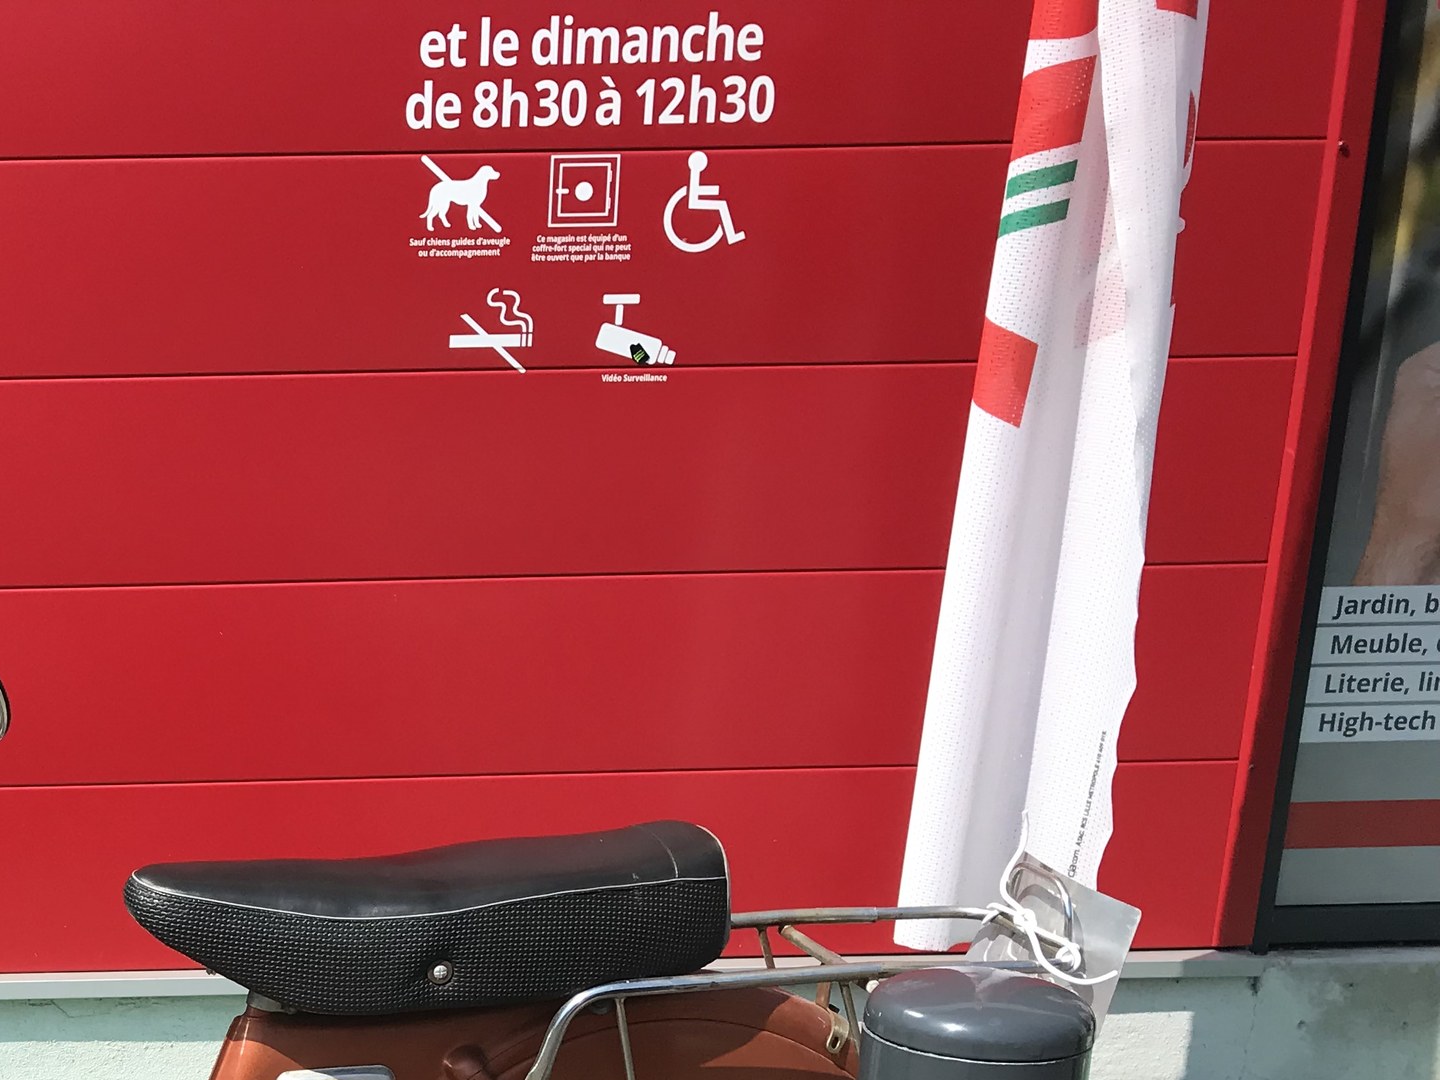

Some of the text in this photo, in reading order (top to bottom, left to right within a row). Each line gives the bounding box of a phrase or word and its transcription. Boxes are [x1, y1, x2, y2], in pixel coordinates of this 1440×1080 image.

[419, 11, 764, 68] et le dimanche
[405, 74, 775, 130] de 8h30 à 12h30
[409, 236, 511, 248] Sauf chiens guides d'aveugle
[536, 234, 546, 243] Ce
[546, 234, 575, 244] magasin
[576, 235, 587, 243] est
[612, 234, 628, 242] d'un
[418, 248, 501, 258] ou d'accompagnement
[532, 244, 567, 252] coffre-fort
[592, 244, 604, 253] qui
[615, 243, 632, 253] peut
[546, 253, 570, 262] ouvert
[570, 254, 584, 263] que
[584, 254, 596, 263] par
[597, 253, 604, 261] la
[604, 252, 631, 262] banque
[601, 373, 668, 382] Vidéo Surveillance
[1331, 593, 1416, 620] Jardin,
[1330, 632, 1428, 655] Meuble,
[1324, 672, 1410, 695] Literie,
[1318, 710, 1436, 737] High-tech
